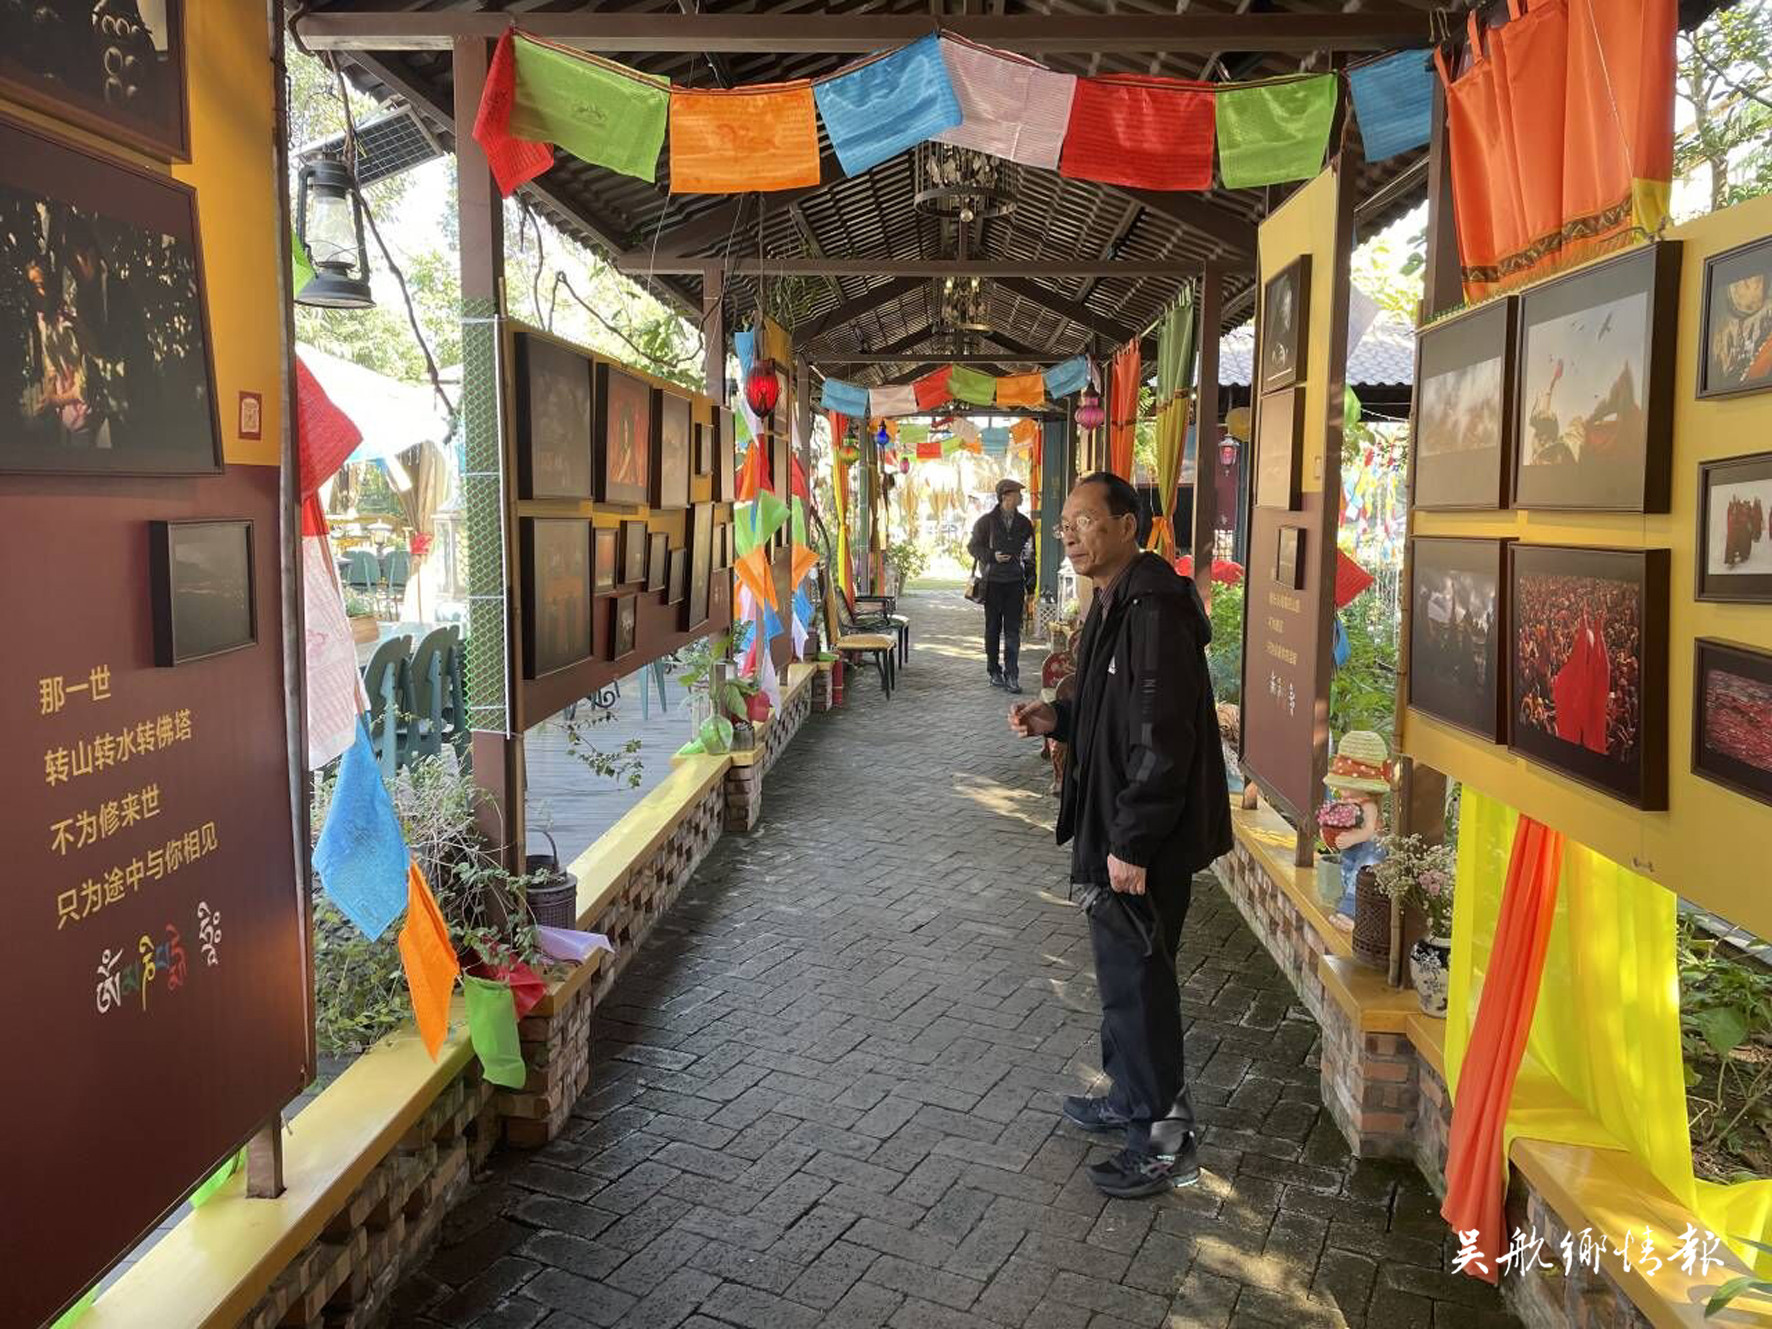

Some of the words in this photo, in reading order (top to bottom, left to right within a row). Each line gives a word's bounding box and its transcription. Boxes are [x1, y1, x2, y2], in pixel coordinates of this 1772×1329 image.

[39, 665, 112, 715] 那一世
[44, 709, 192, 787] 转山转水转佛塔
[50, 783, 161, 857] 不为修来世
[57, 821, 219, 930] 只为途中与你相见
